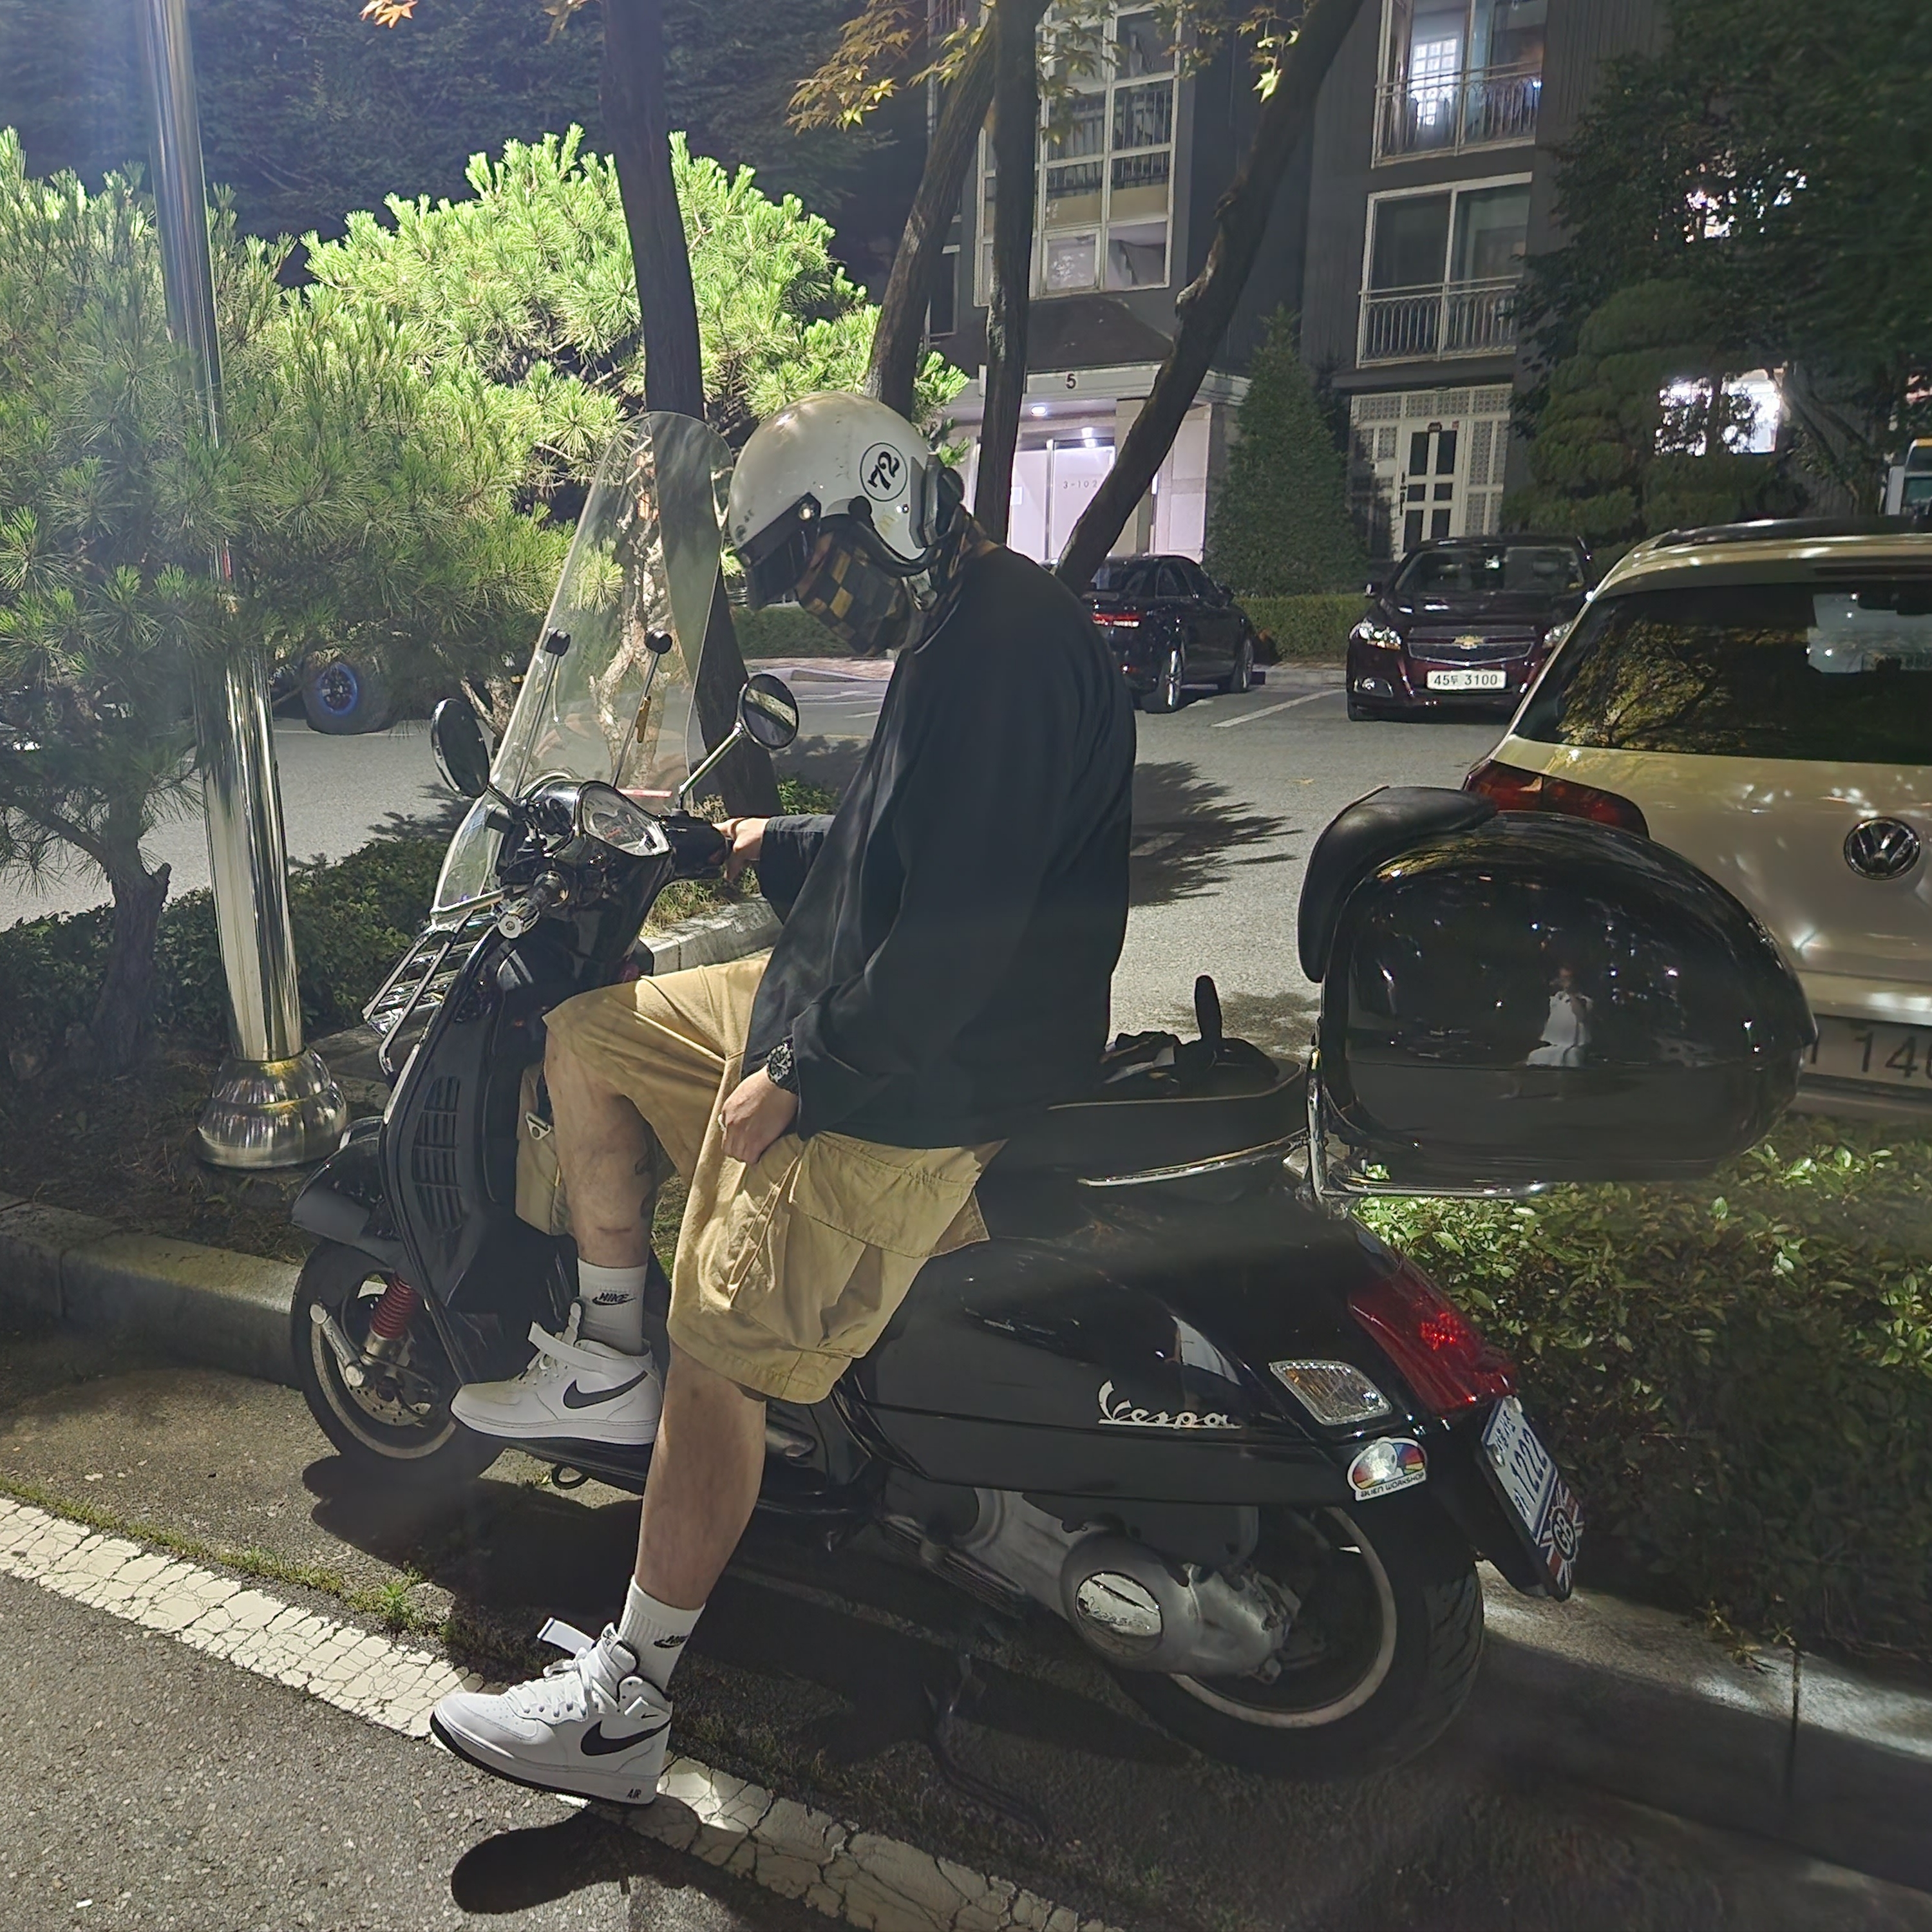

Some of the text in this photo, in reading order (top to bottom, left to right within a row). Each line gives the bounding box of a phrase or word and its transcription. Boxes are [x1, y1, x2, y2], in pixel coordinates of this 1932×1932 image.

[1066, 374, 1076, 389] 5
[867, 451, 900, 491] 72
[1464, 674, 1497, 685] 3100
[599, 1292, 629, 1302] NIKE
[1098, 1379, 1242, 1429] Vespa
[1510, 1427, 1547, 1504] 1222
[1386, 1472, 1425, 1490] WORKSHOP
[1553, 1512, 1574, 1555] GB
[626, 1788, 641, 1799] AIR
